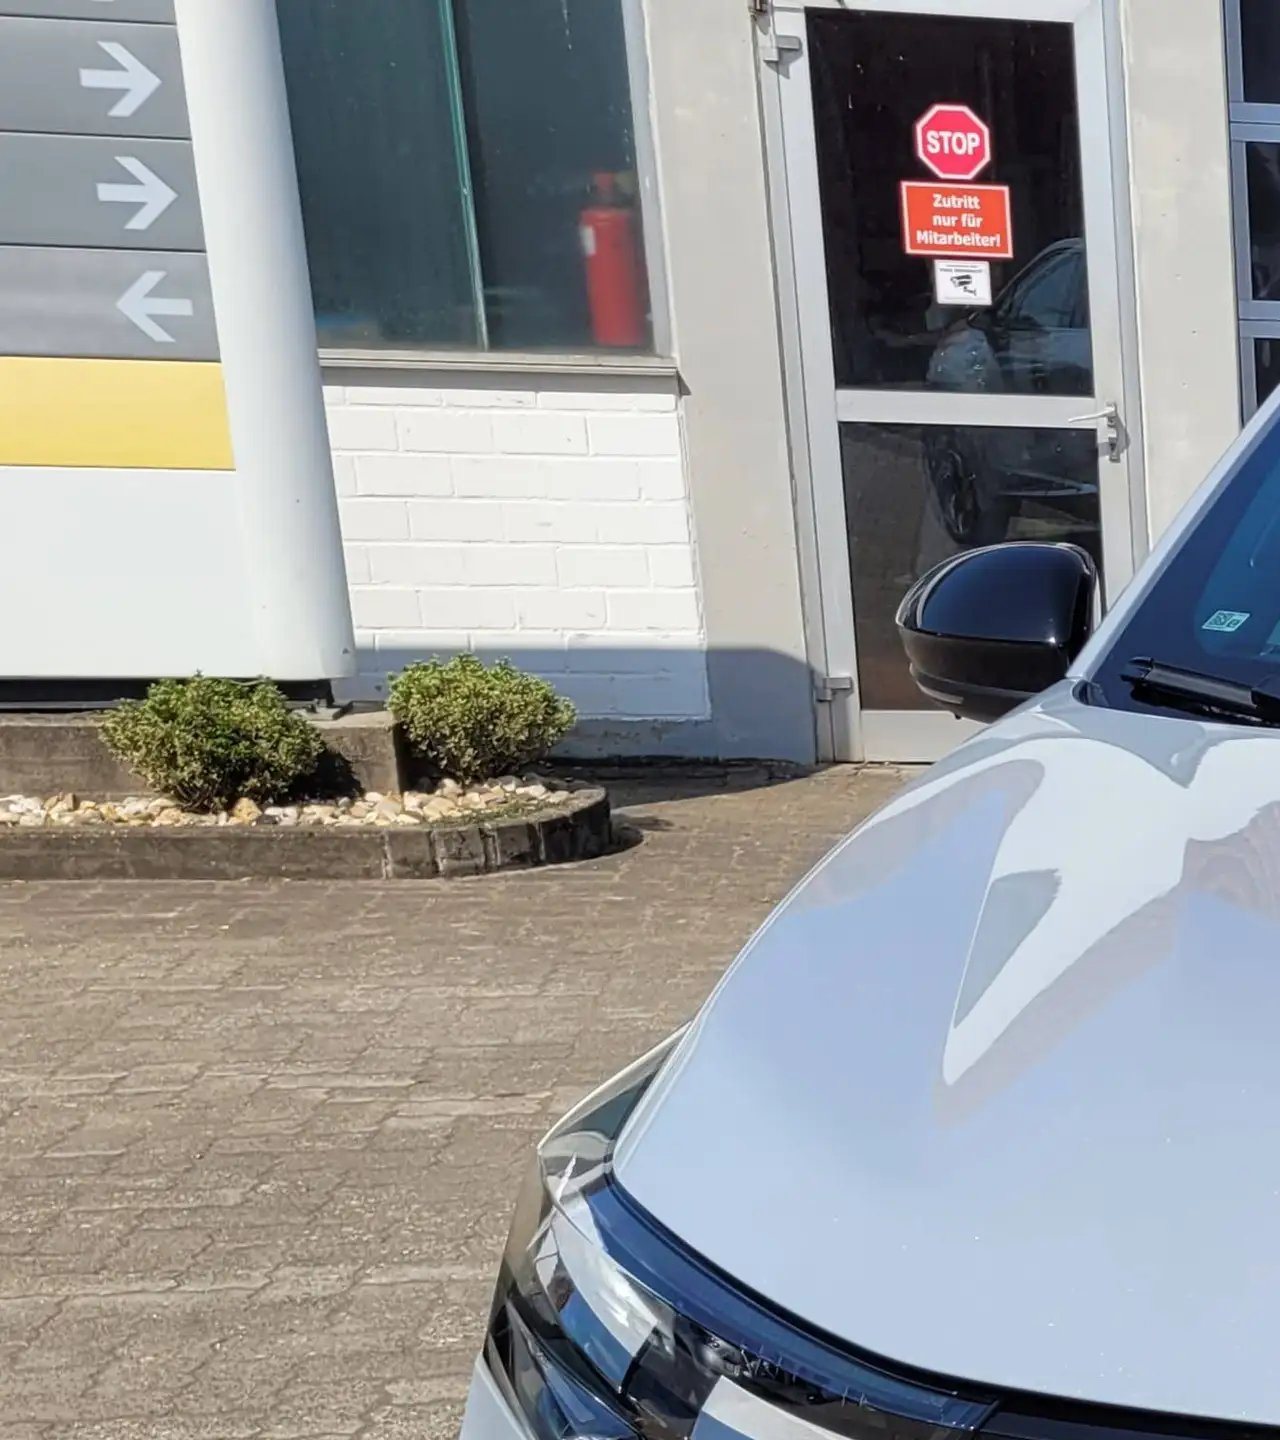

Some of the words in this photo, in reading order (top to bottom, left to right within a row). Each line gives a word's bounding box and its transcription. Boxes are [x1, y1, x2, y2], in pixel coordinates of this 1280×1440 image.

[926, 130, 980, 155] STOP
[932, 193, 980, 209] Zutritt
[932, 214, 957, 227] nur
[961, 213, 983, 228] für
[916, 230, 1001, 247] Mitarbeiter!
